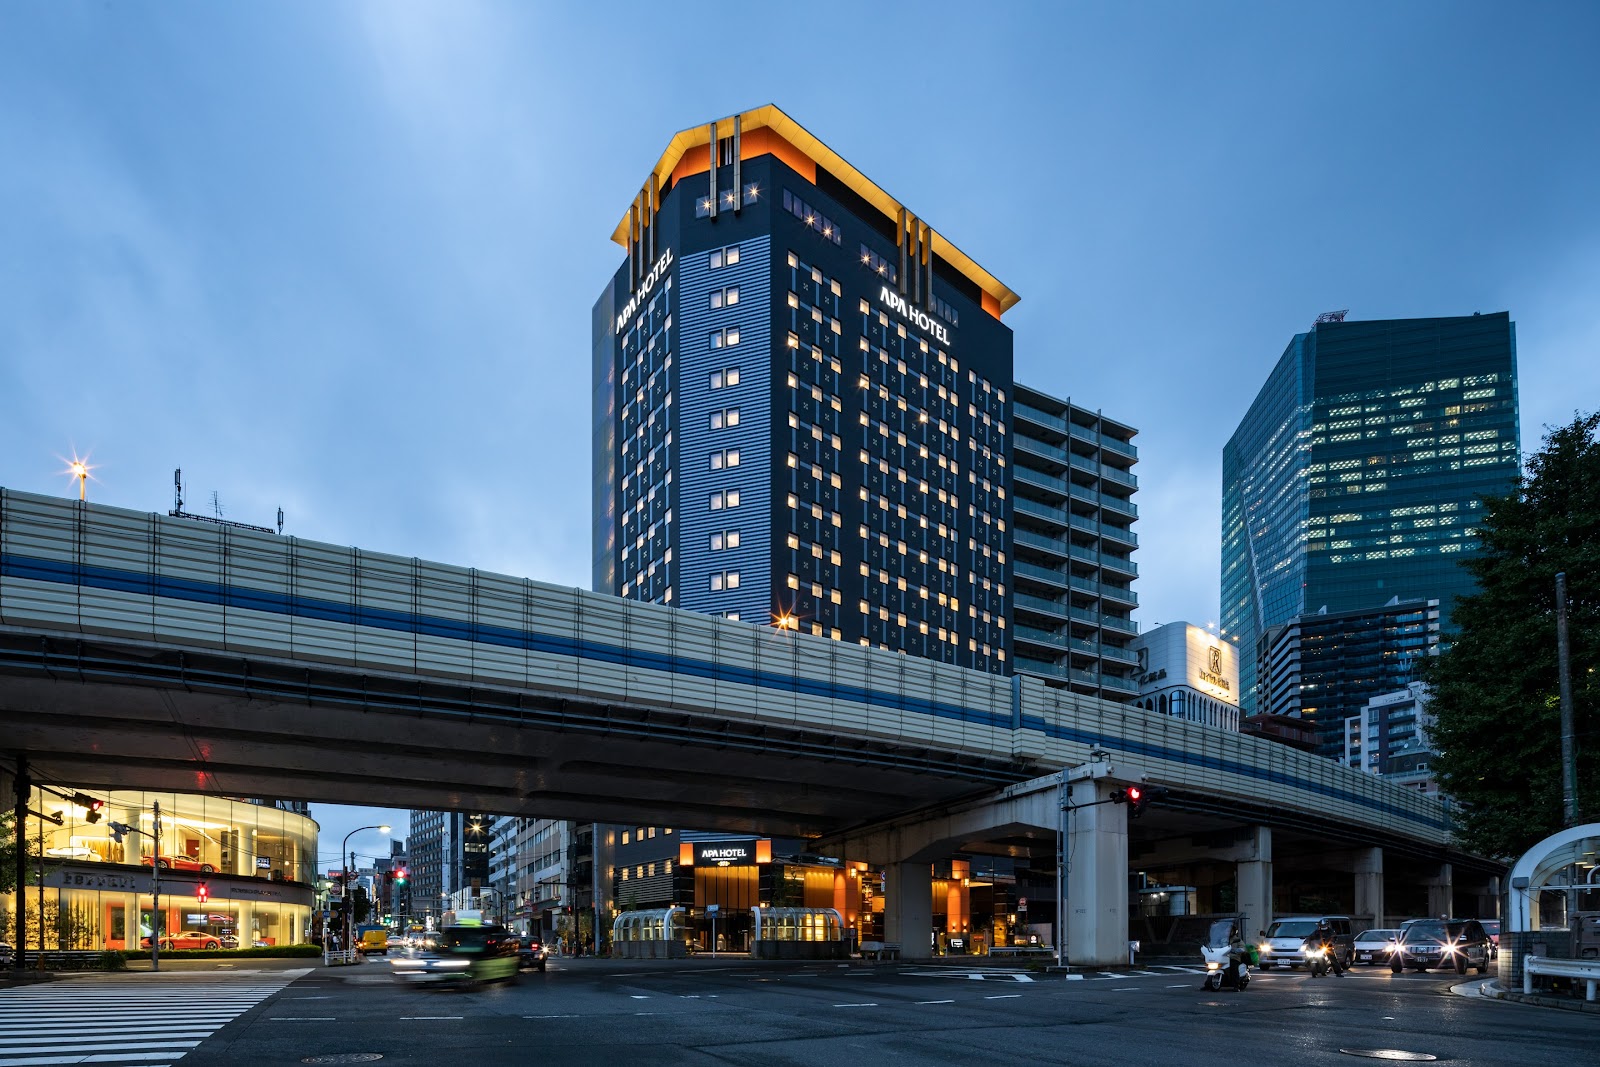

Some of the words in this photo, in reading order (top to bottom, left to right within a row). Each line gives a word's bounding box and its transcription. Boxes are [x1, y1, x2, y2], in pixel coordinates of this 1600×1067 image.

[616, 298, 636, 335] APA
[637, 248, 675, 306] HOTEL
[880, 286, 907, 317] APA
[908, 305, 950, 345] HOTEL
[702, 850, 718, 858] APA
[719, 849, 747, 857] HOTEL
